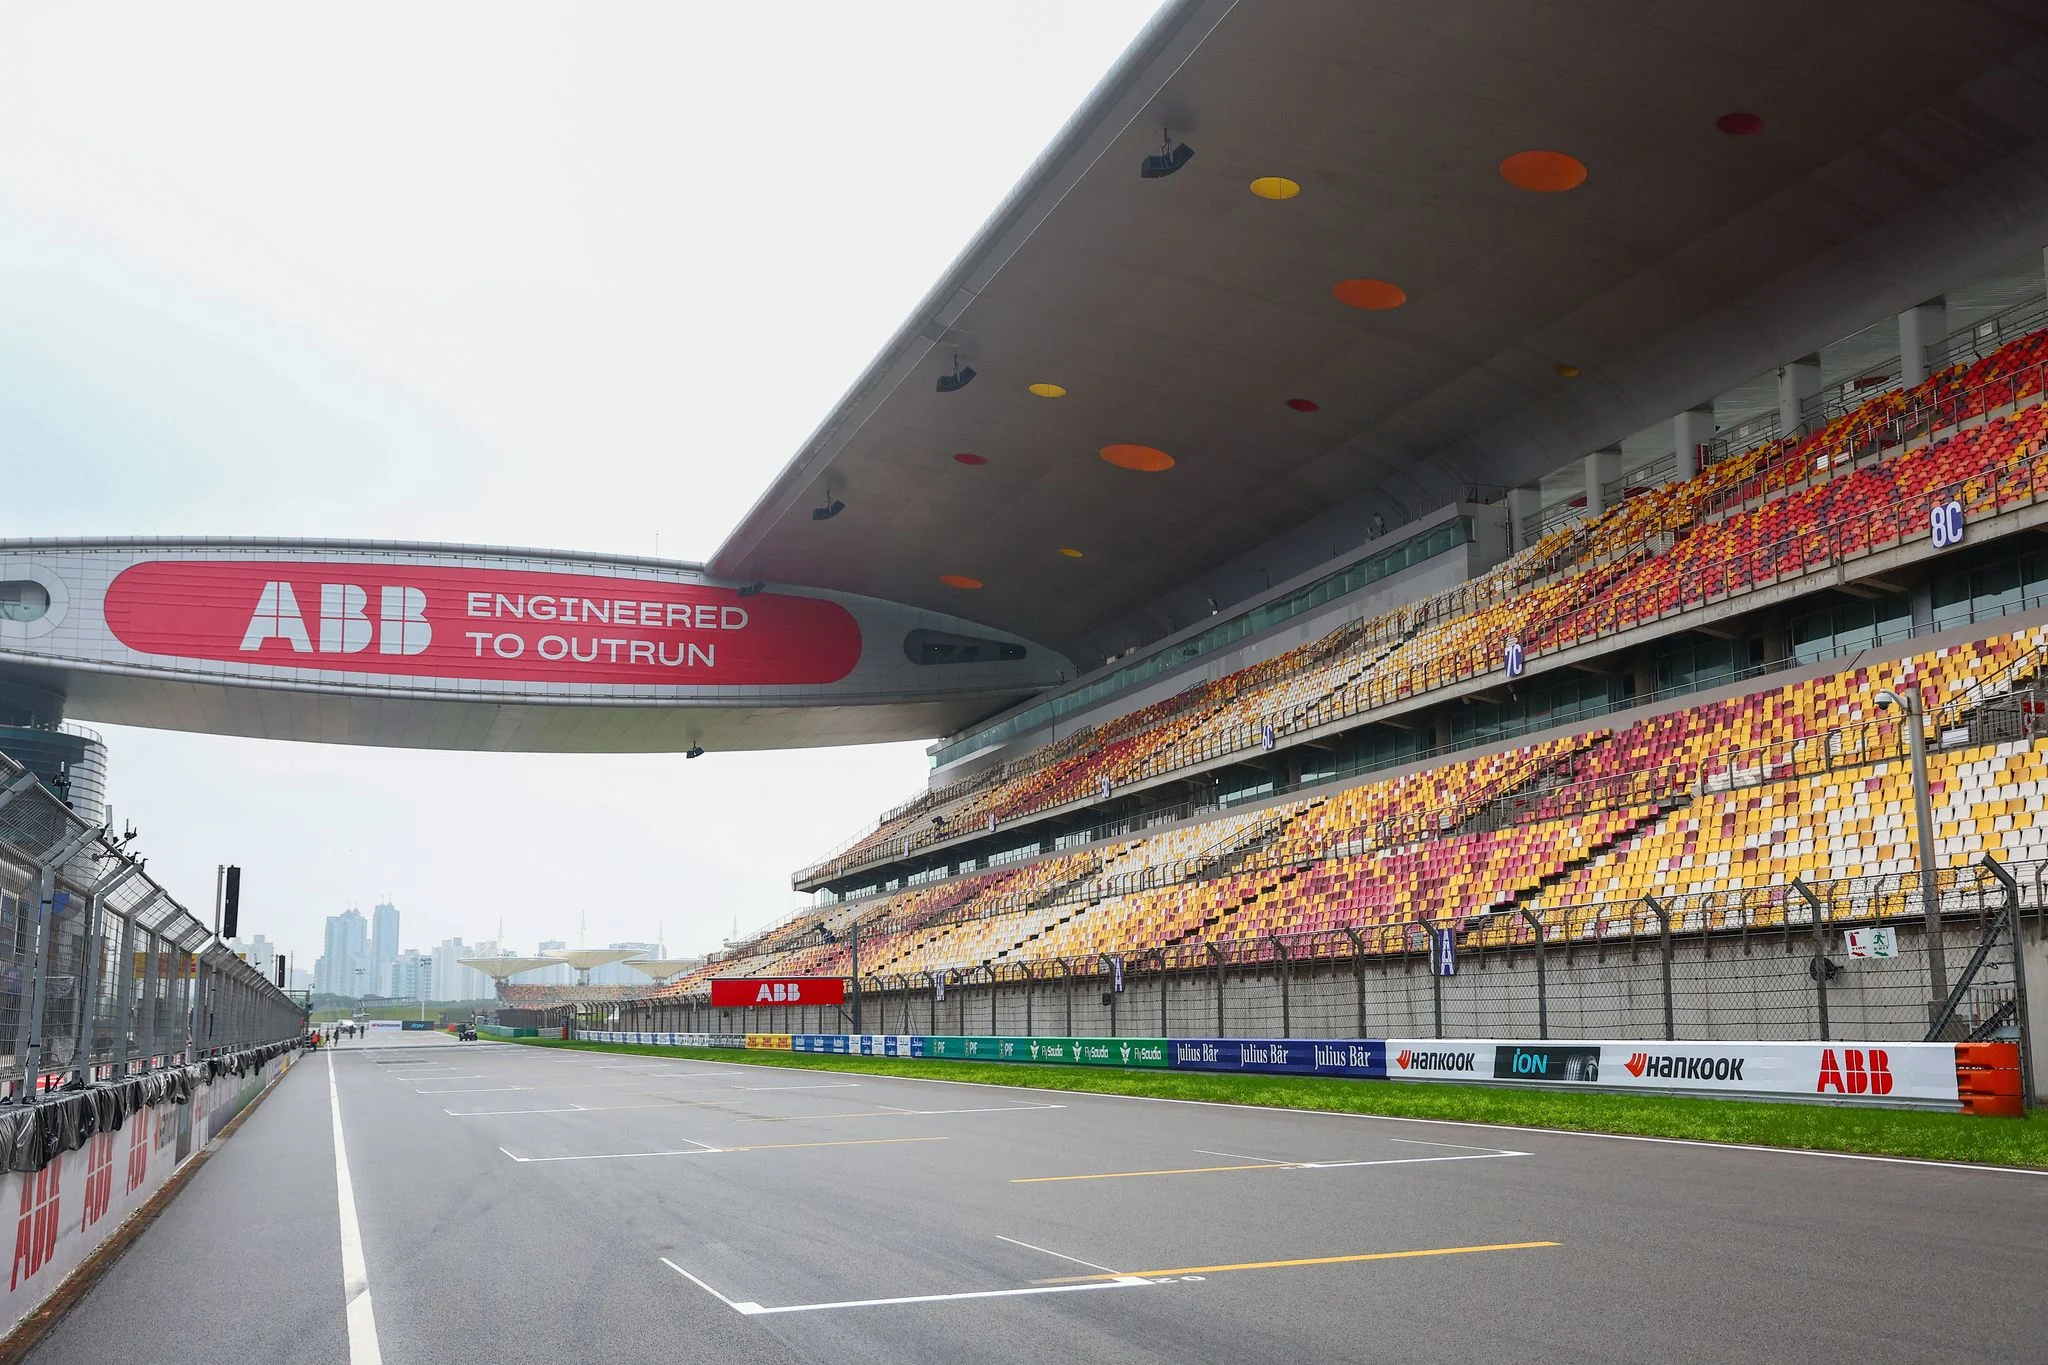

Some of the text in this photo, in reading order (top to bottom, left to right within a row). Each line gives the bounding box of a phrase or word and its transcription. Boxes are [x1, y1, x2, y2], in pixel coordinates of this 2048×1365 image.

[1931, 501, 1963, 548] 8C
[239, 581, 433, 655] ABB
[467, 592, 749, 629] ENGINEERED
[465, 632, 715, 667] TO OUTRUN
[1505, 644, 1522, 677] 7C
[1262, 724, 1273, 750] 6C
[1430, 928, 1455, 975] A
[756, 983, 800, 1002] ABB
[1176, 1043, 1219, 1065] Julius Bär
[1240, 1043, 1289, 1068] Julius Bär
[1314, 1044, 1371, 1071] Julius Bär
[1817, 1049, 1893, 1095] ABB
